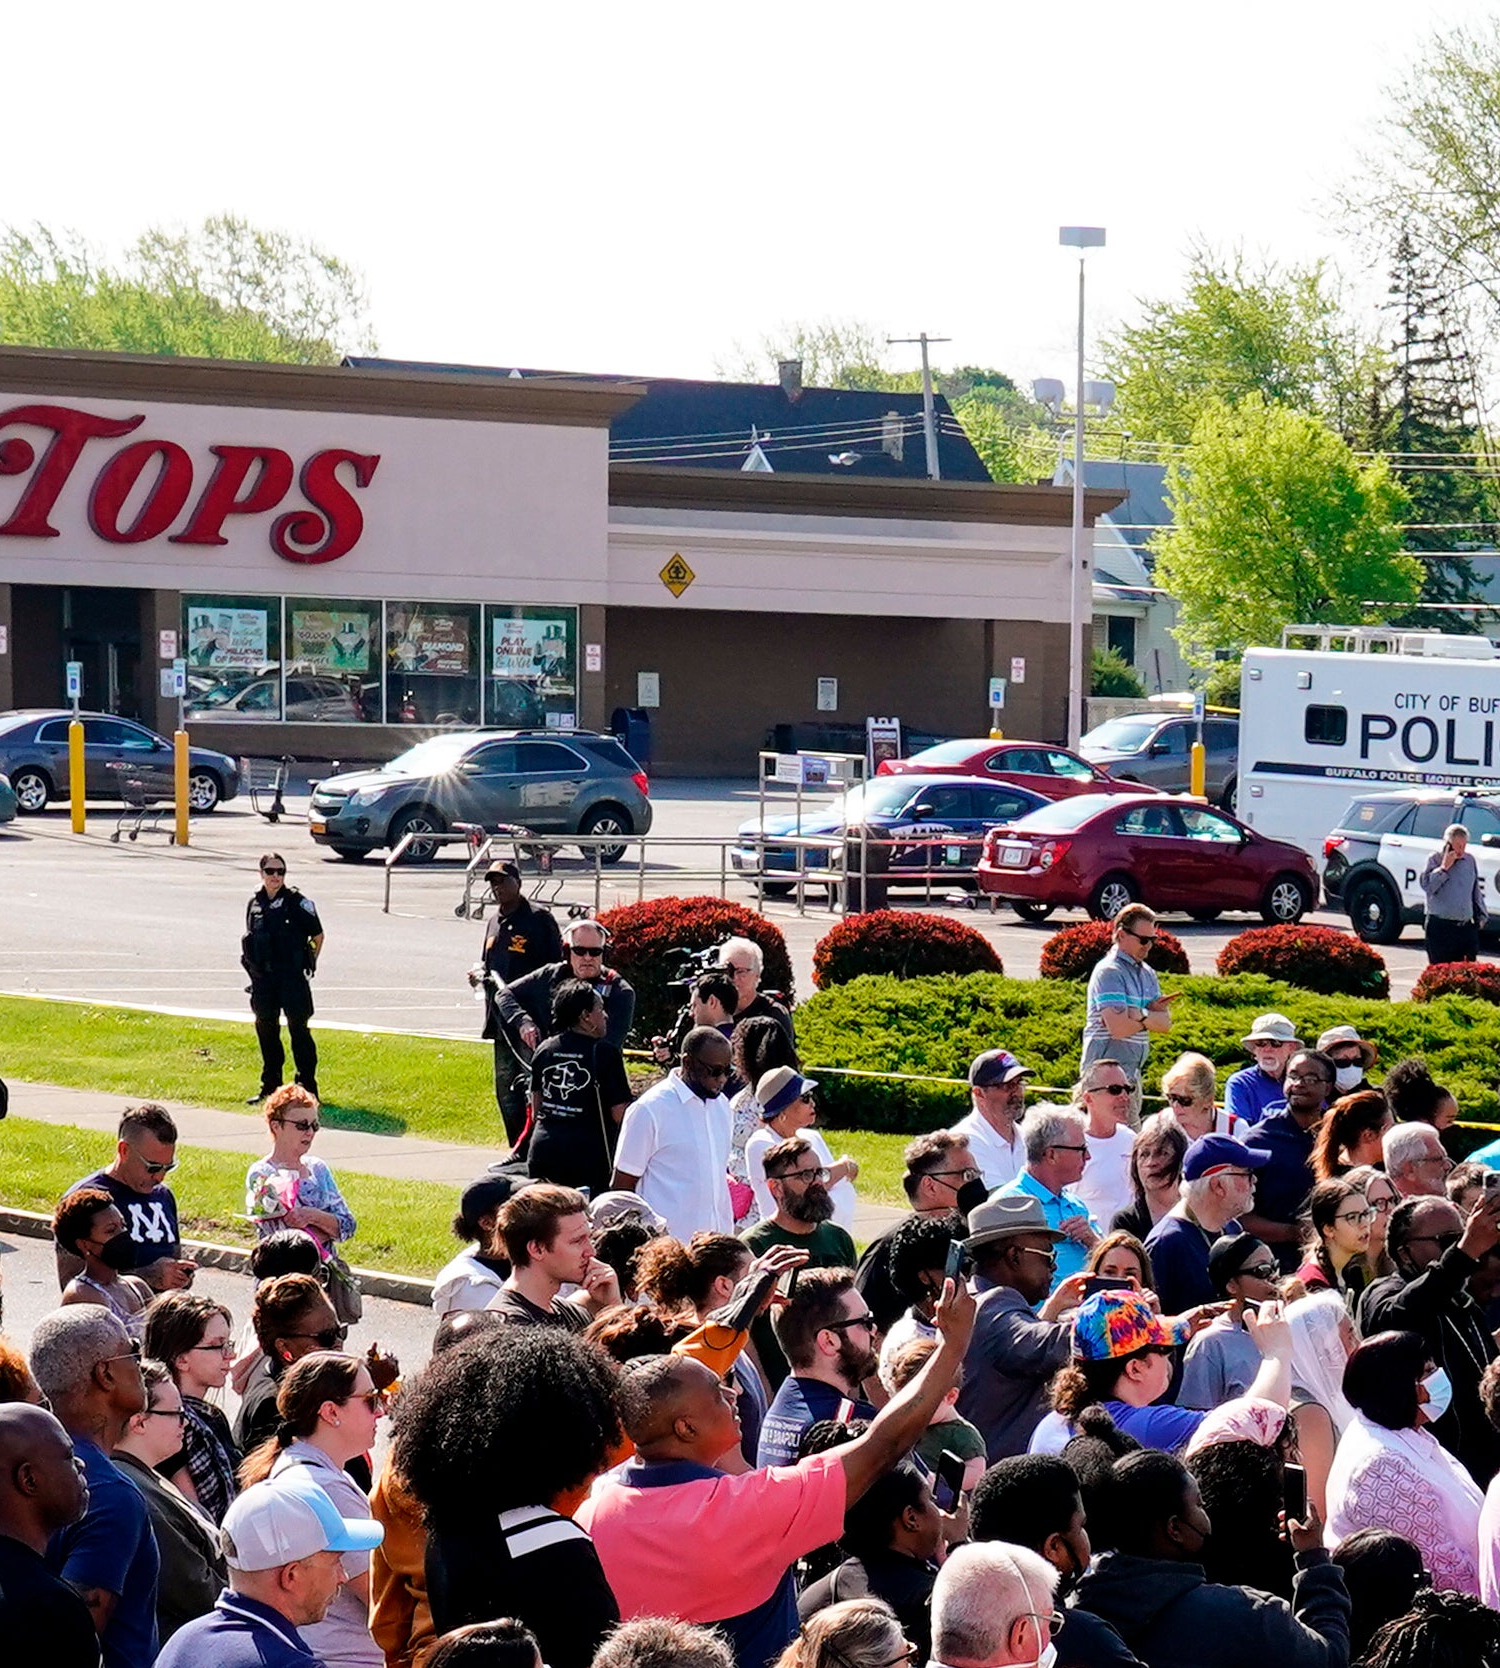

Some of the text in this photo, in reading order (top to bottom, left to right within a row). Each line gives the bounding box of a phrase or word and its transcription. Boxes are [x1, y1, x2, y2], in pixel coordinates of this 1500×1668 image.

[501, 636, 528, 646] PLAY
[225, 648, 264, 656] MILLIONS
[422, 642, 465, 652] DIAMOND
[495, 646, 533, 656] ONLINE
[1394, 693, 1431, 710] CITY
[1439, 695, 1460, 711] OF
[1325, 766, 1377, 780] BUFFALO
[1380, 770, 1423, 783] POLICE
[1426, 774, 1472, 787] MOBILE
